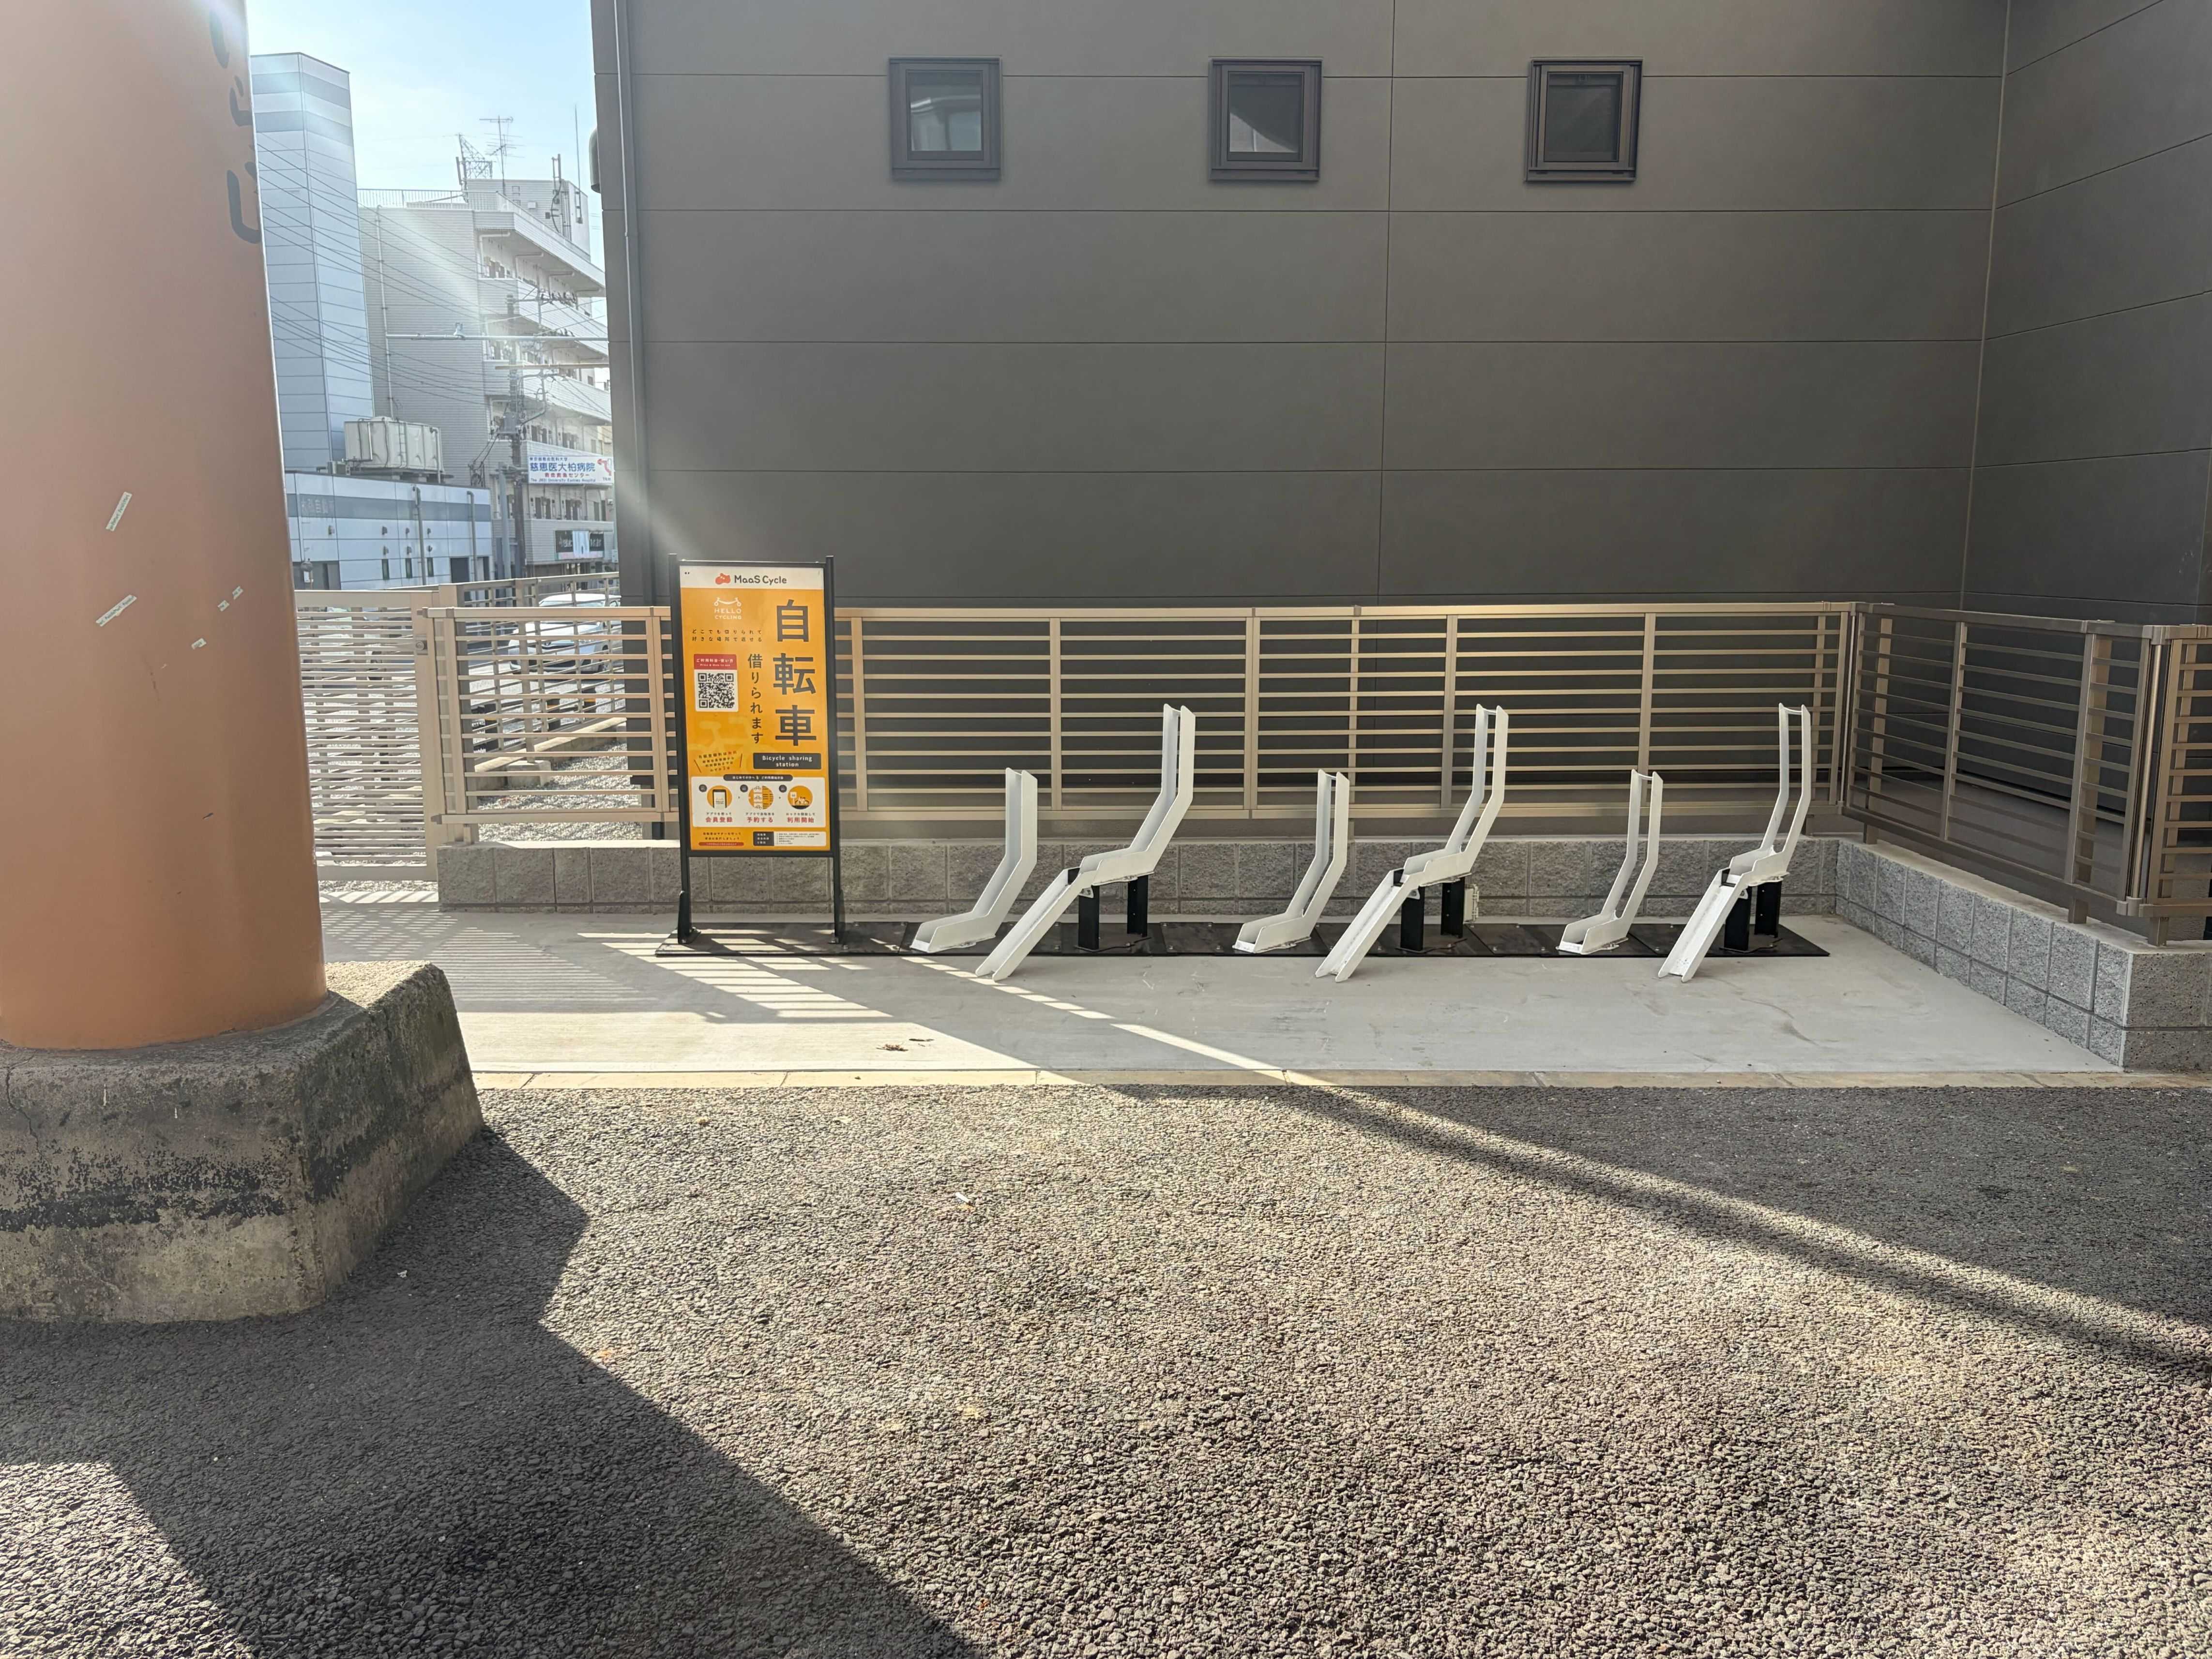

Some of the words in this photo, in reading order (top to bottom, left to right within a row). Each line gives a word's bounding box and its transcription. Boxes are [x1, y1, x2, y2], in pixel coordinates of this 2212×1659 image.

[530, 462, 596, 472] 慈恵医大柏病院
[734, 575, 760, 584] MaaS
[762, 575, 787, 585] Cycle
[773, 599, 817, 746] 自転車
[748, 654, 763, 743] 借りられます
